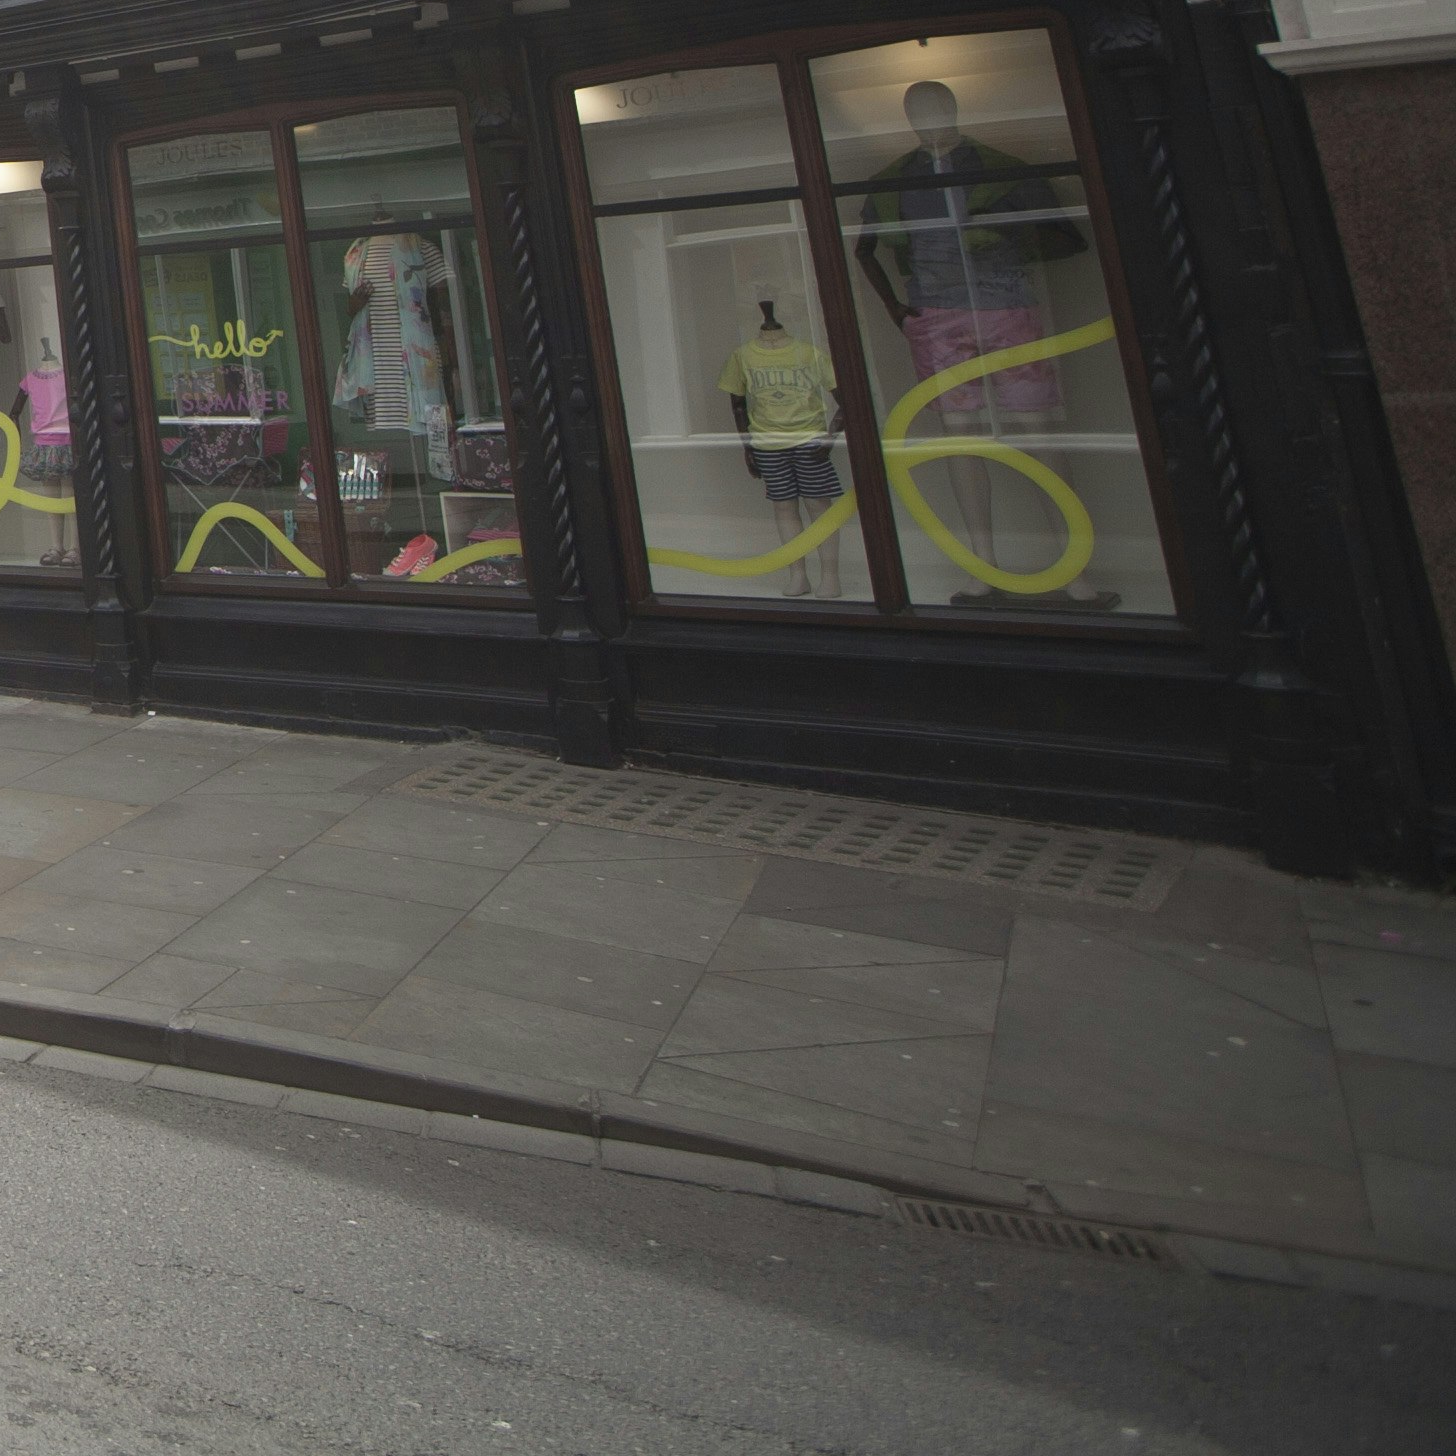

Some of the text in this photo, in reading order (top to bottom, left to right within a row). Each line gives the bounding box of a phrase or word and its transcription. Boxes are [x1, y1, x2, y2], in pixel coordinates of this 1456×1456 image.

[156, 141, 243, 166] JOULES
[188, 319, 270, 359] hello
[182, 390, 290, 414] SUMMER
